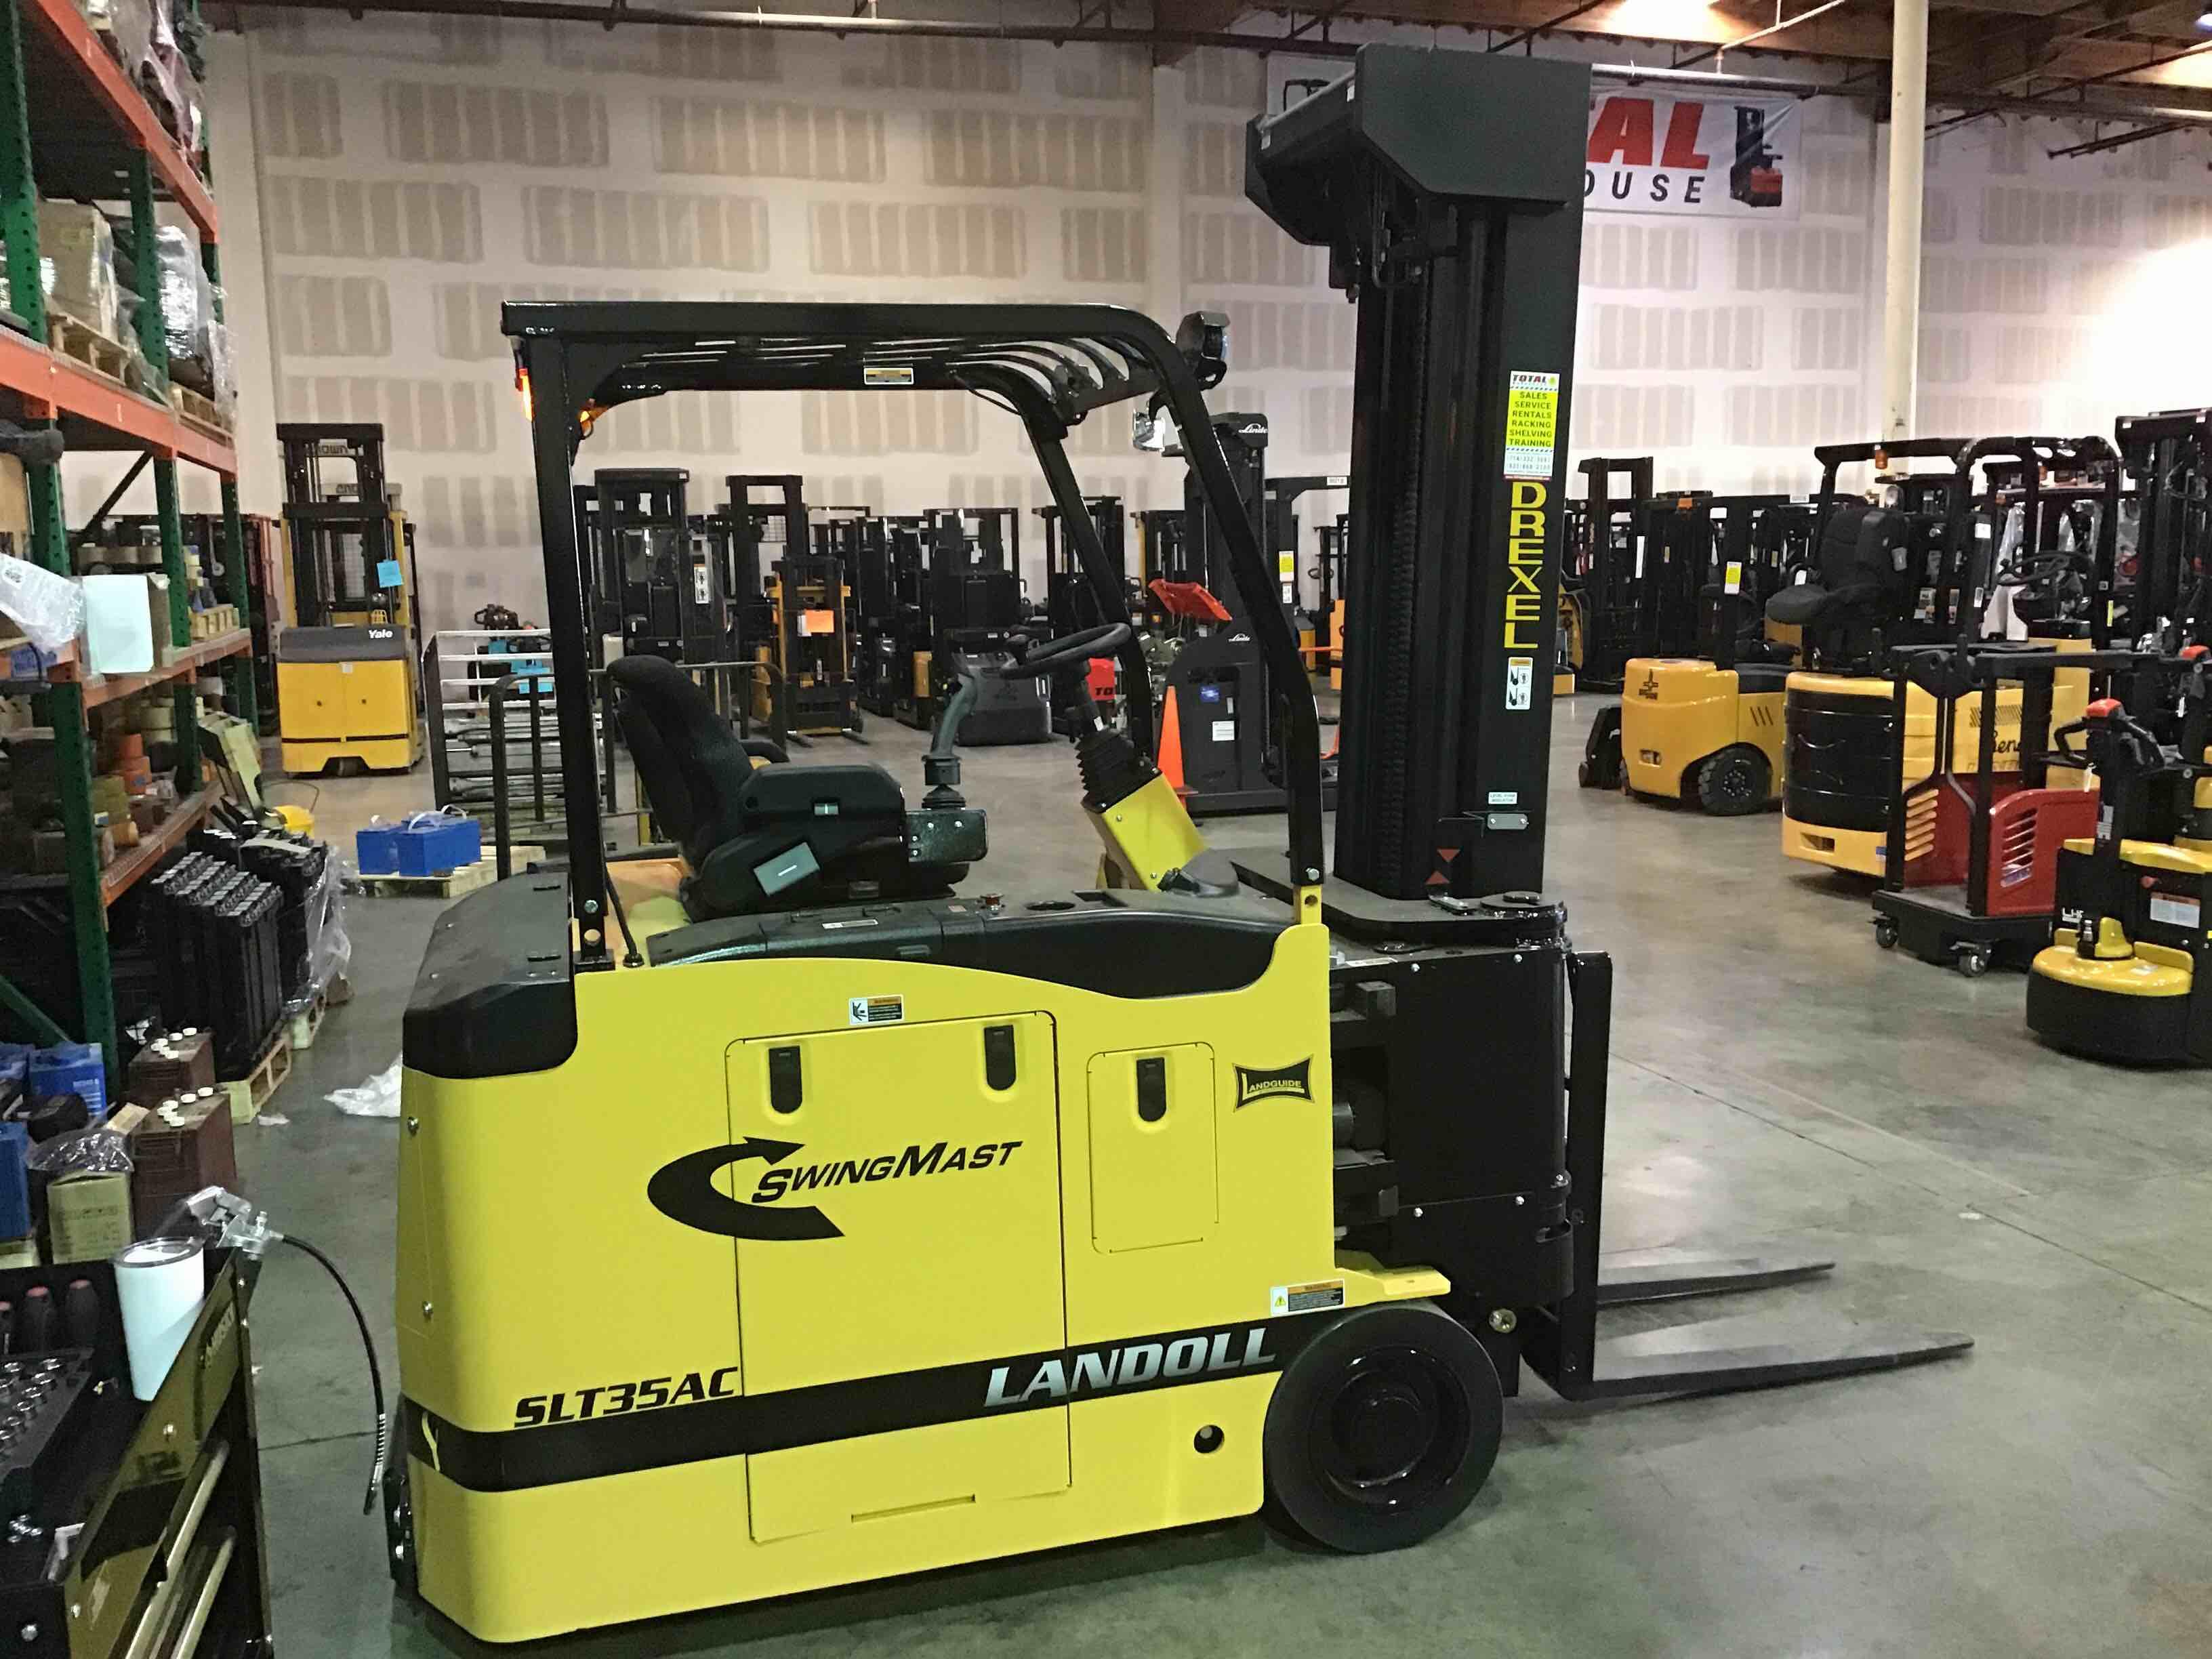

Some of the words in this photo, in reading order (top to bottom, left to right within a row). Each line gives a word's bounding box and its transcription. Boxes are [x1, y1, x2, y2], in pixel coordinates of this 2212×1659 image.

[1586, 97, 1709, 169] AL
[1519, 391, 1548, 400] SALES
[1515, 401, 1551, 409] SERVICE
[1512, 410, 1552, 419] RENTALS
[1511, 419, 1551, 428] RACKING
[1509, 429, 1552, 438] SHELVING
[1509, 438, 1551, 447] TRAINING
[1504, 481, 1547, 649] DREXEL
[368, 629, 393, 638] Yale
[1242, 1072, 1305, 1101] LANDGUIDE
[984, 1328, 1276, 1407] LANDOLL
[514, 1366, 738, 1428] SLT35AC
